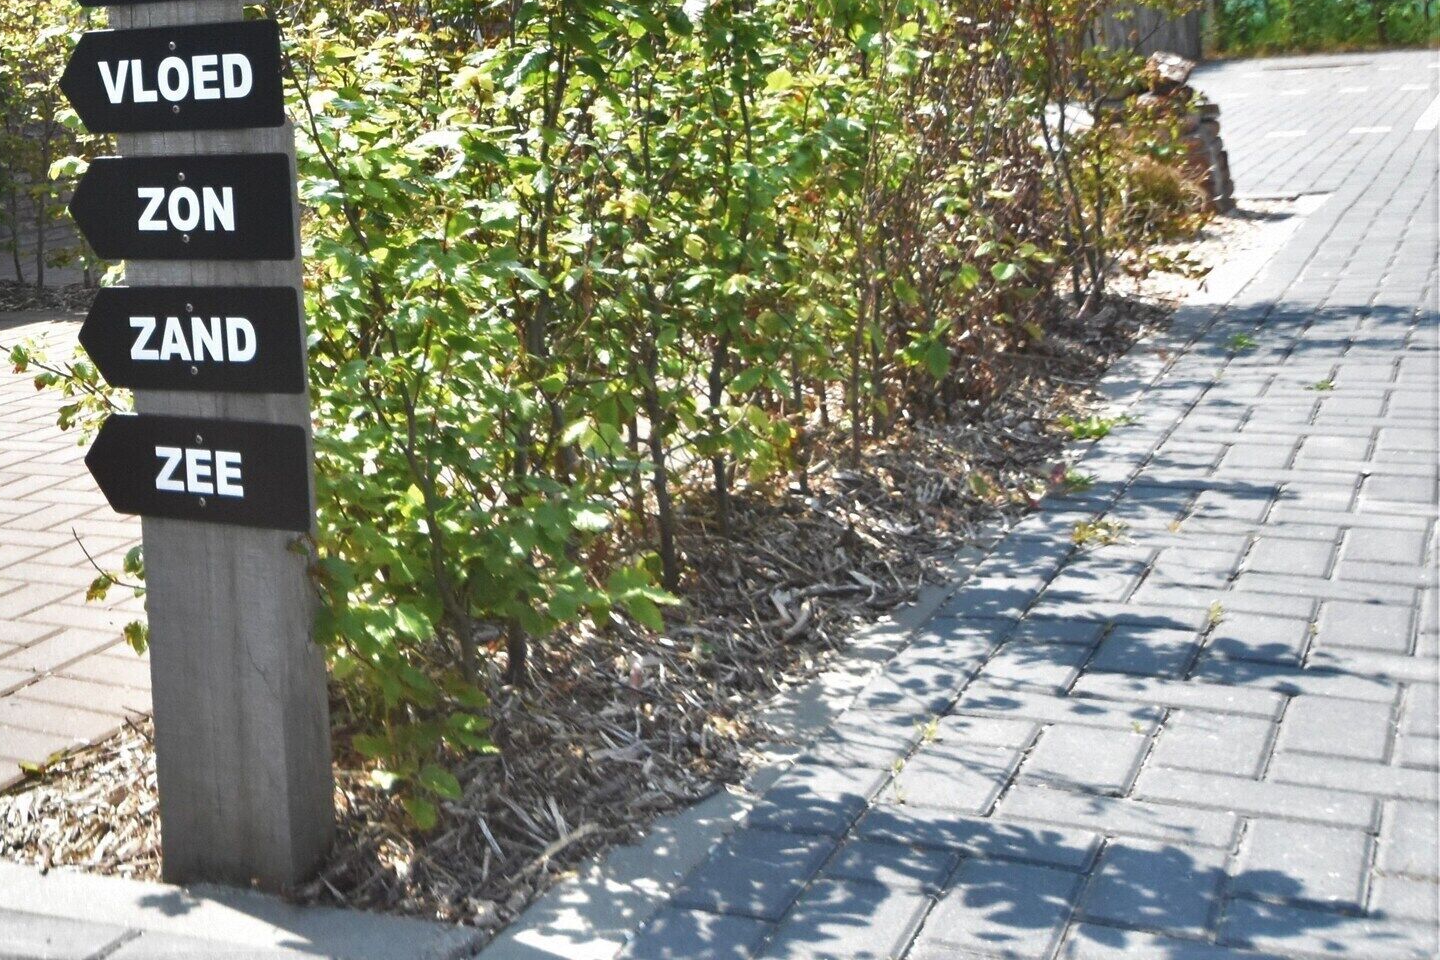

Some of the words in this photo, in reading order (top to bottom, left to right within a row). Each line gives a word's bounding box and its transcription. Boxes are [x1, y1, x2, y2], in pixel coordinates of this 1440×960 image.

[97, 53, 253, 104] VLOED
[137, 186, 235, 232] ZON
[129, 316, 257, 362] ZAND
[155, 446, 244, 497] ZEE
